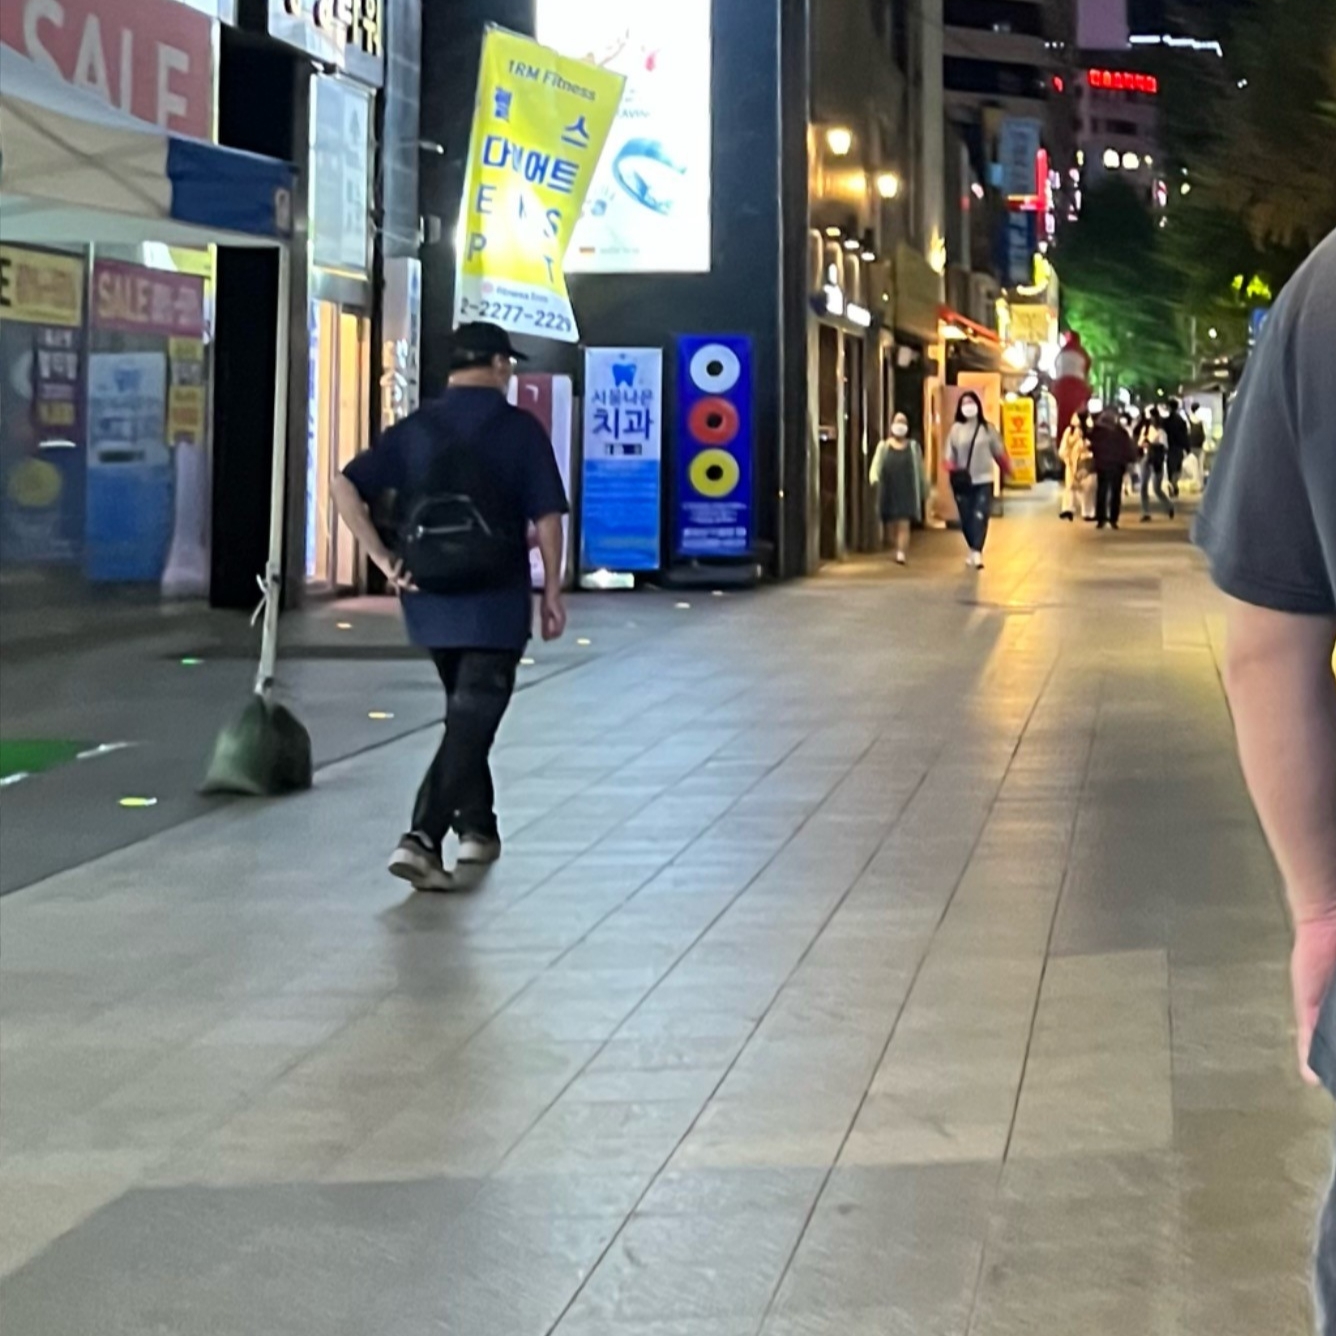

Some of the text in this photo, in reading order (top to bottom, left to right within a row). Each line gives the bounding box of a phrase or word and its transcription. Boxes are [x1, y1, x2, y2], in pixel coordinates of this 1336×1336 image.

[23, 2, 190, 128] SALE
[543, 69, 597, 102] Fitness
[592, 407, 655, 441] 치과
